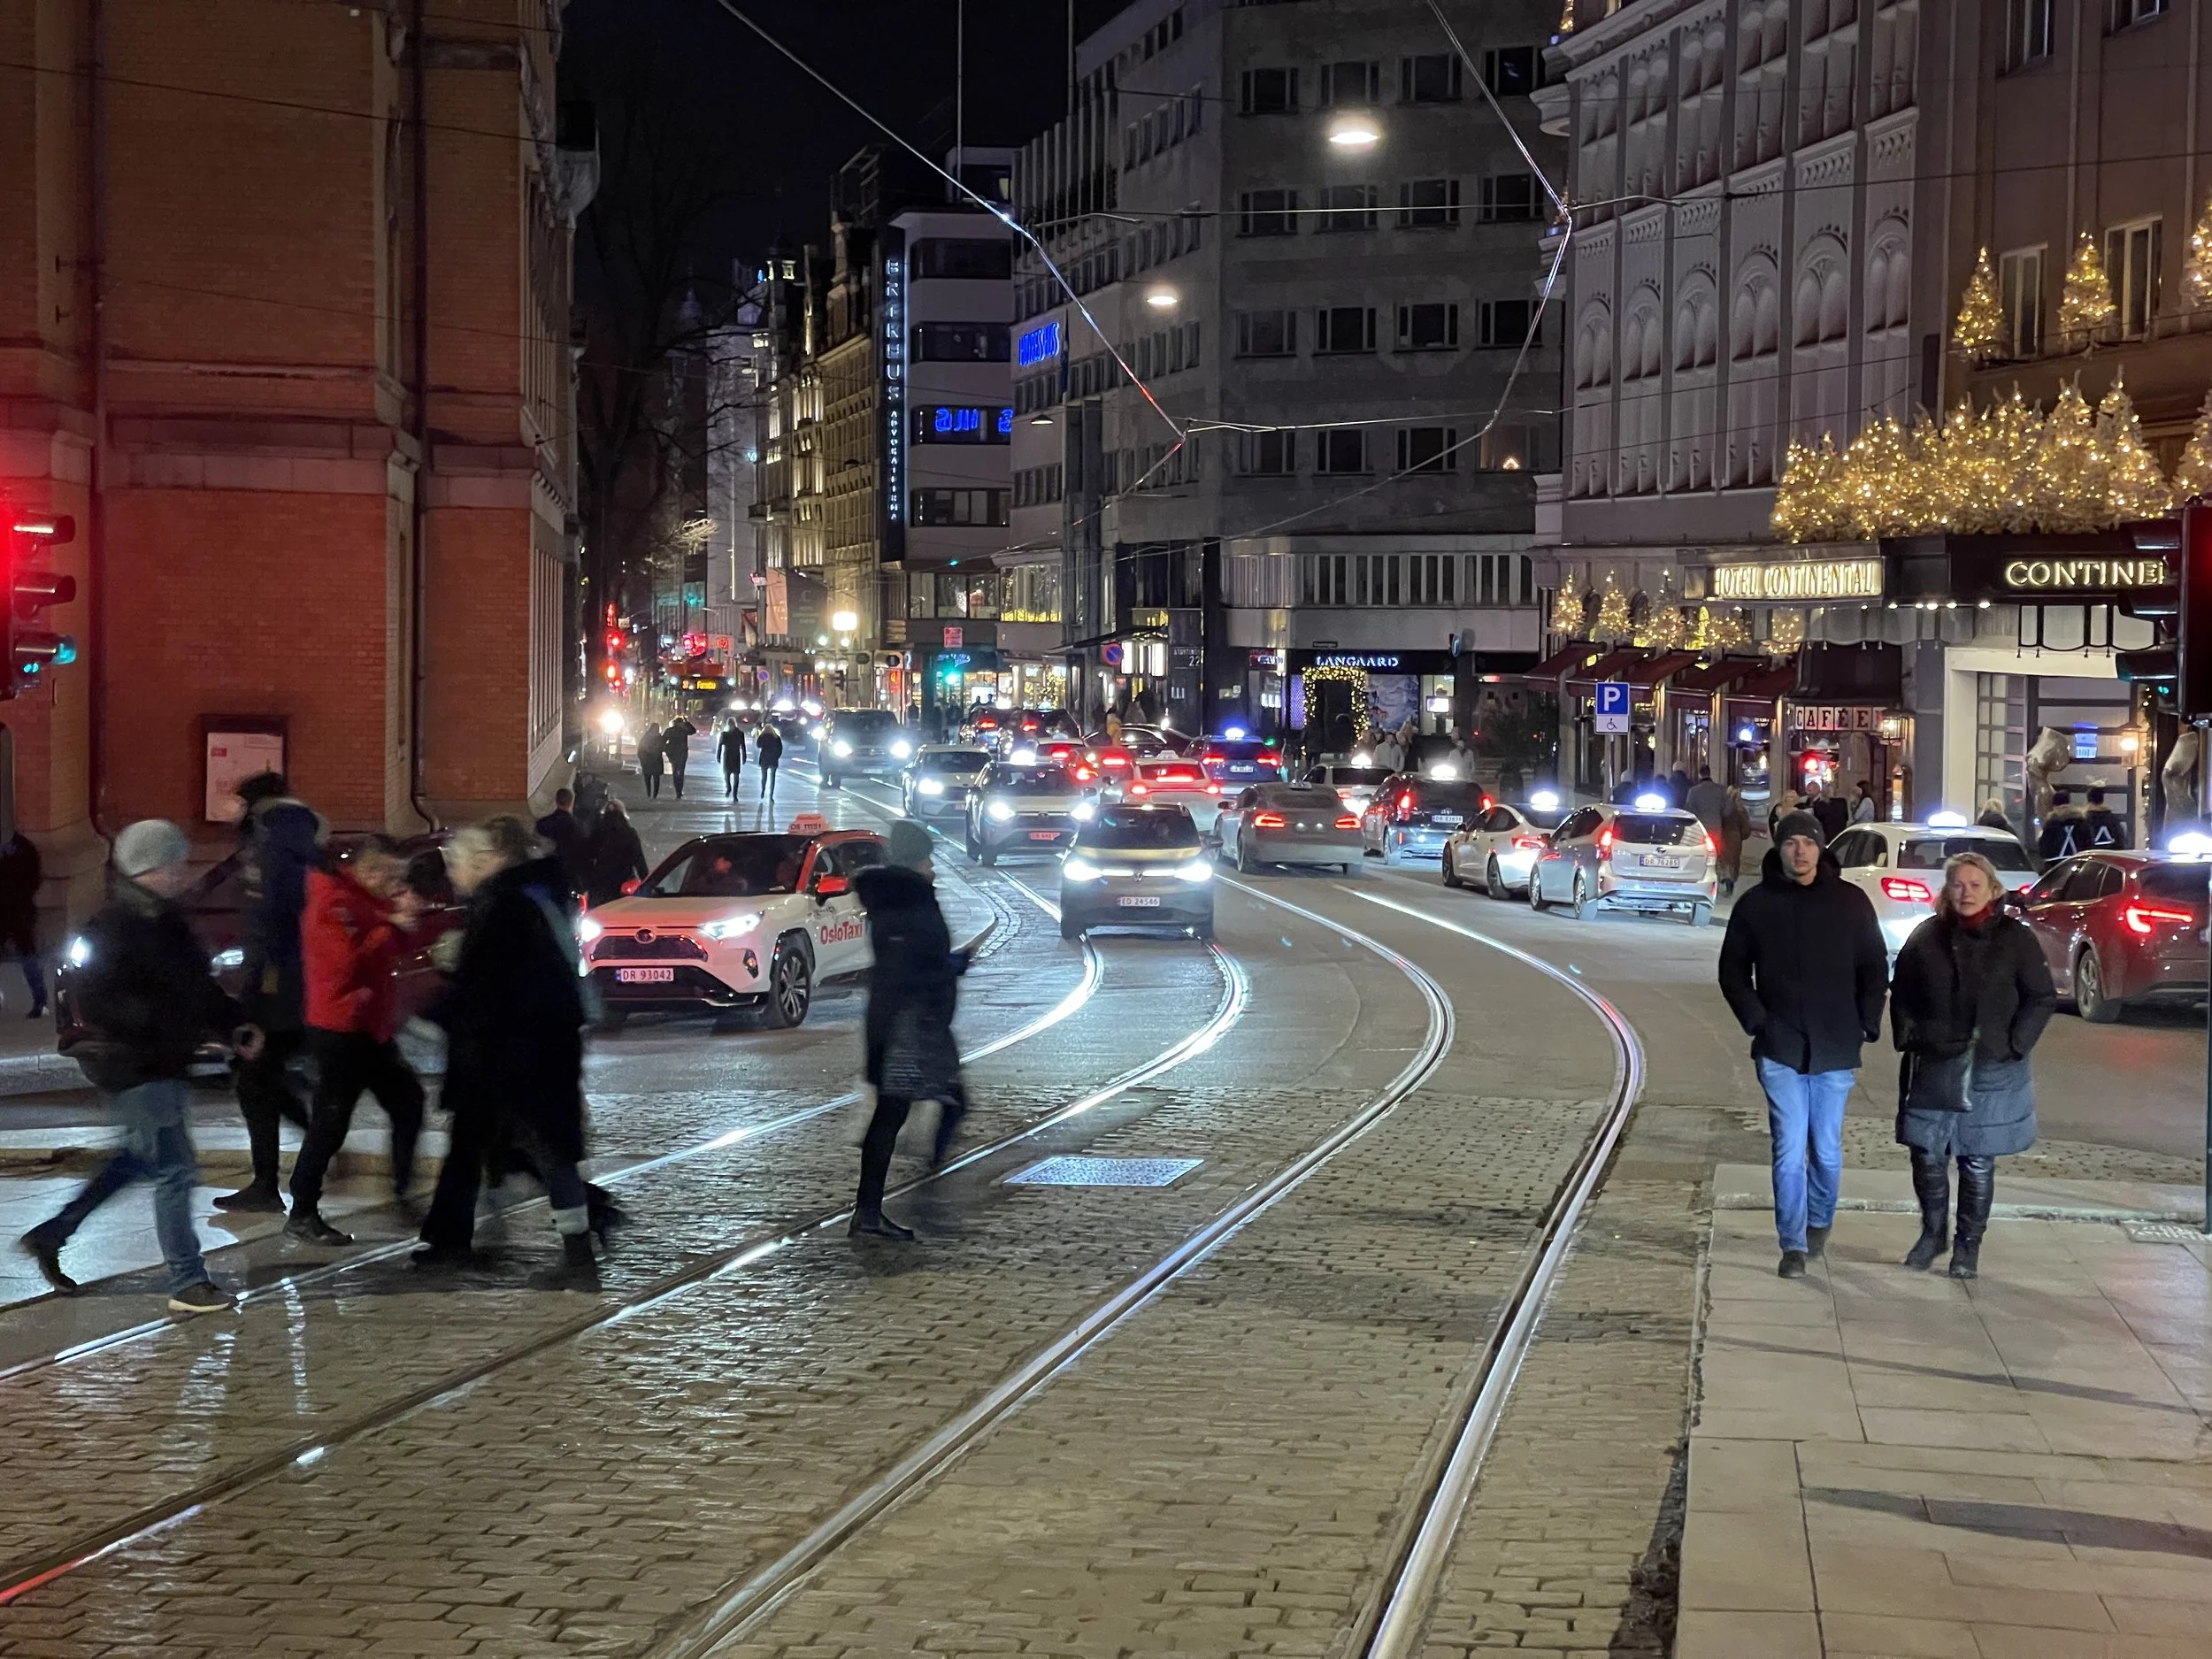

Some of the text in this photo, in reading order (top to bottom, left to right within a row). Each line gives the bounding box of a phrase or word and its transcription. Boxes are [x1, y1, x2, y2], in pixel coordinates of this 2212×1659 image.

[1715, 562, 1875, 595] HOTEL CONTINENTAL
[1189, 656, 1200, 666] 22
[1316, 656, 1399, 667] LANGAARD
[1603, 687, 1621, 711] P
[820, 921, 864, 944] OsloTaxi
[623, 970, 672, 980] DR 93042
